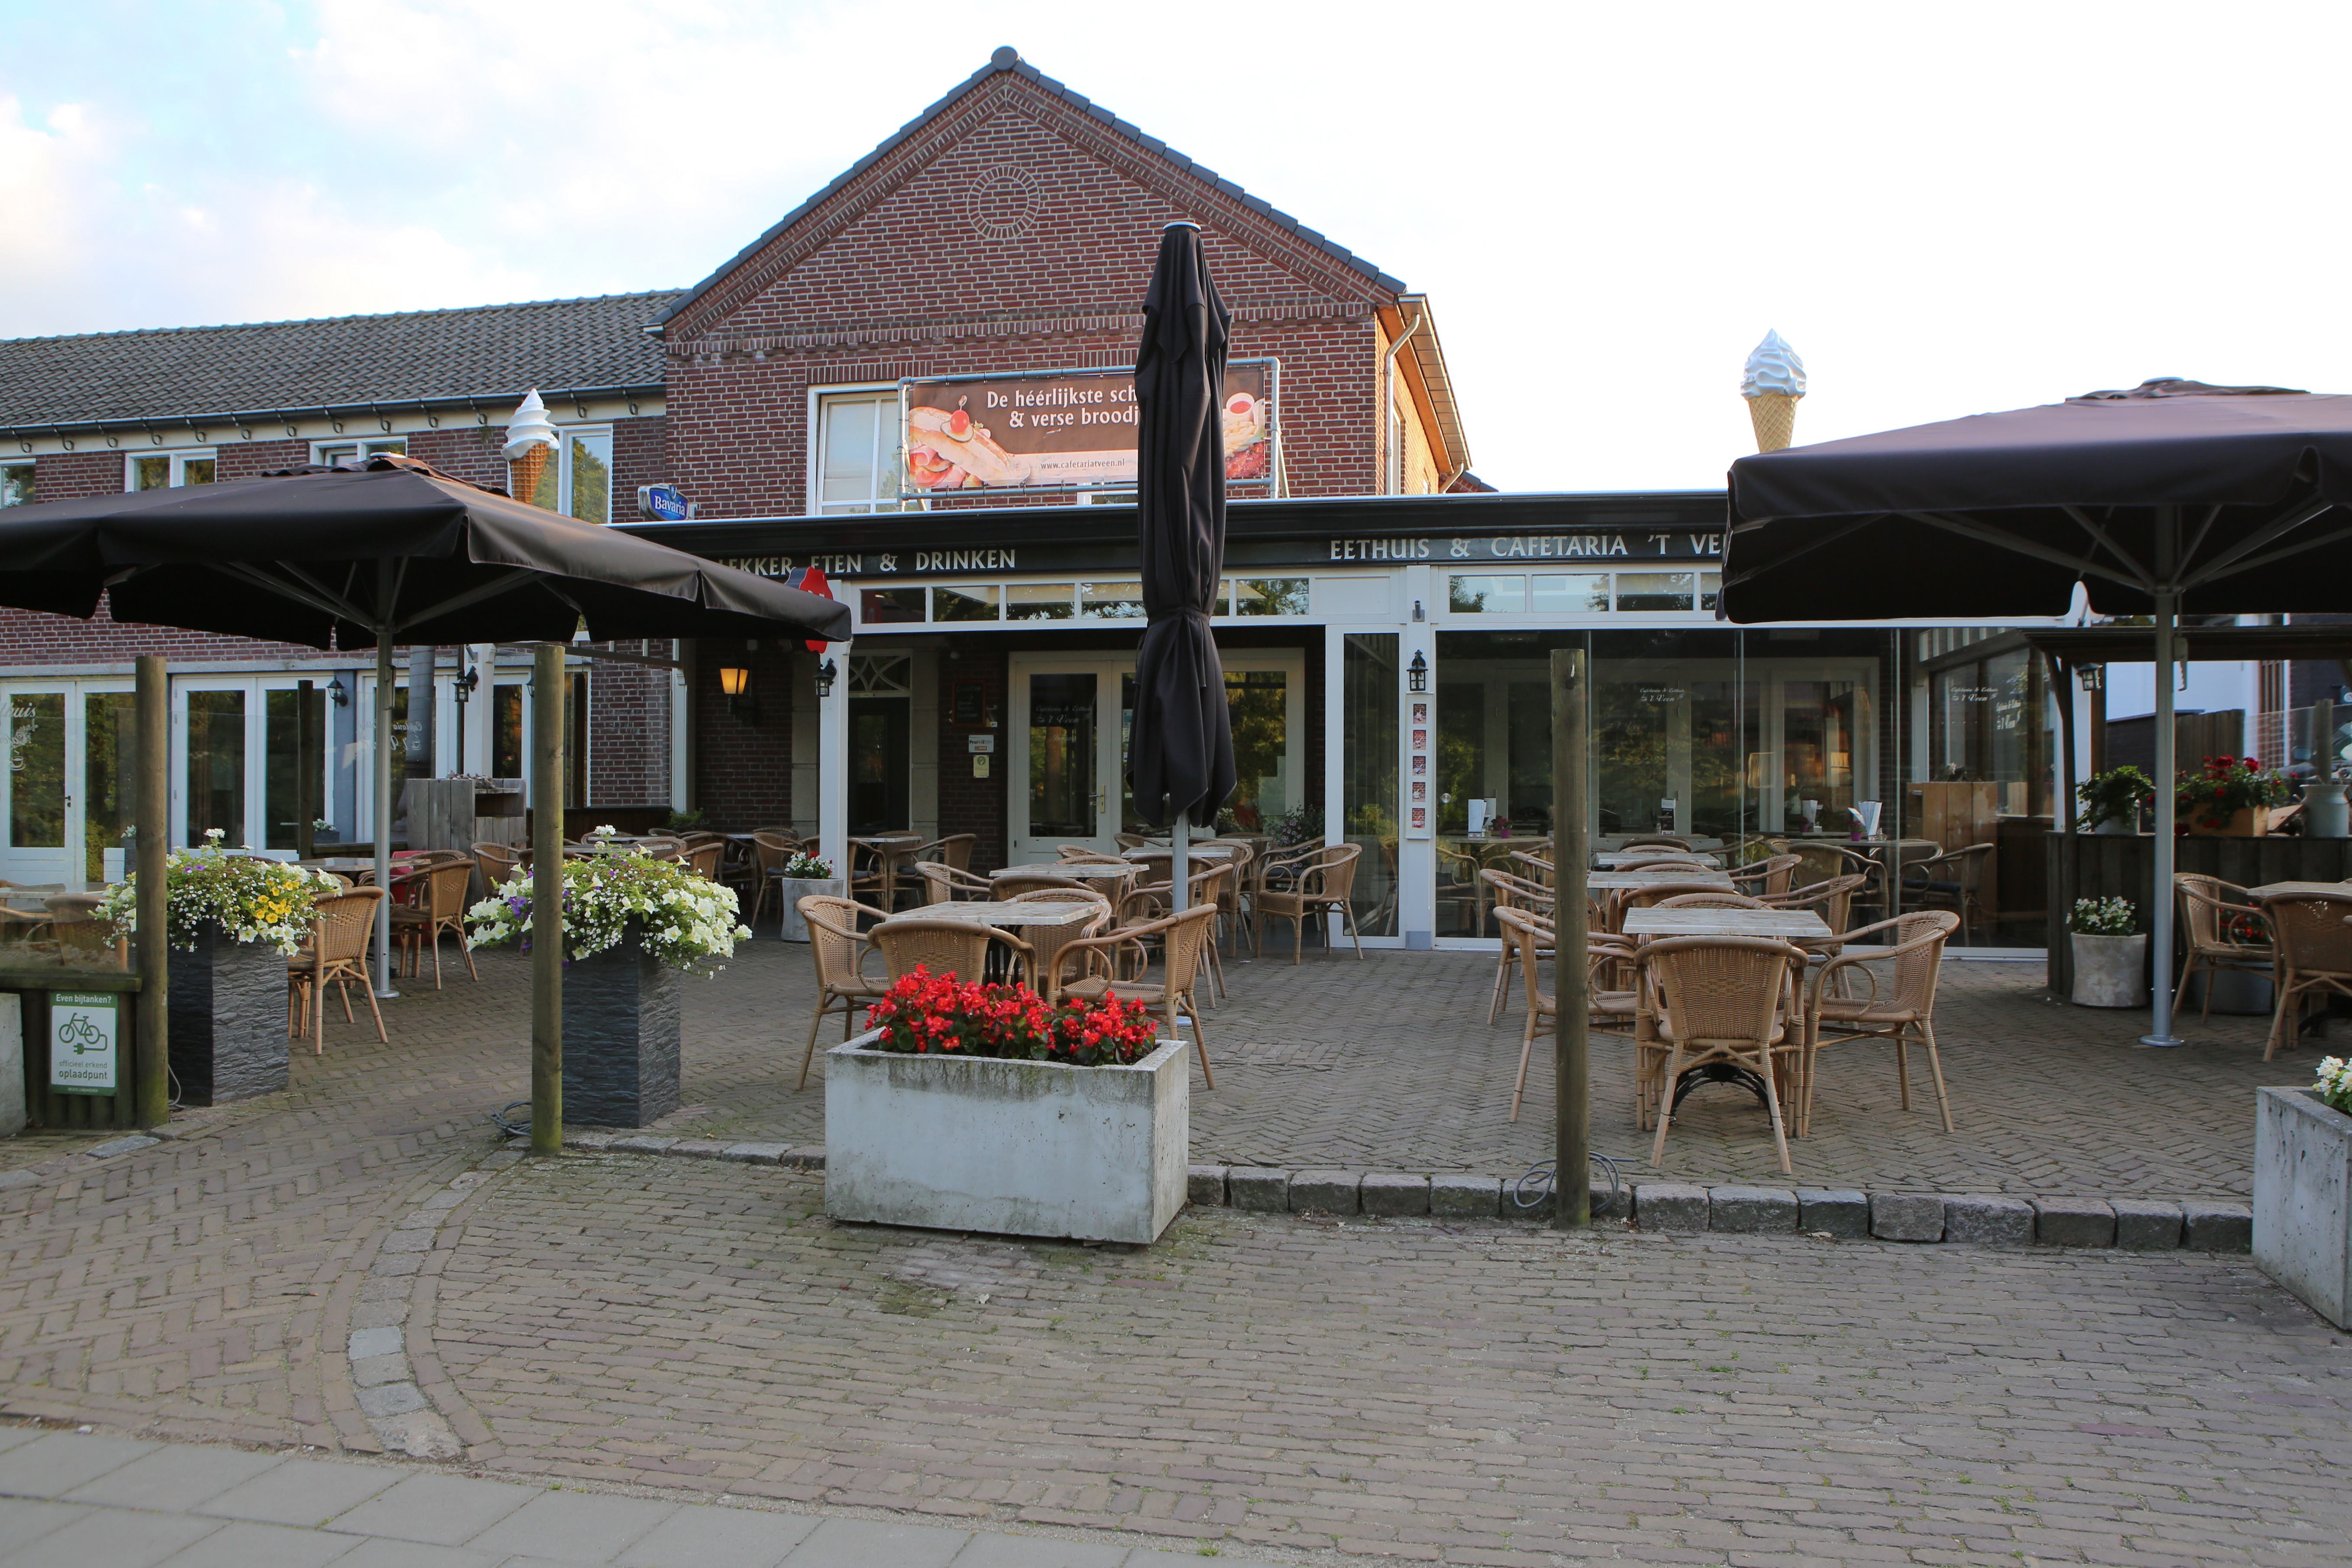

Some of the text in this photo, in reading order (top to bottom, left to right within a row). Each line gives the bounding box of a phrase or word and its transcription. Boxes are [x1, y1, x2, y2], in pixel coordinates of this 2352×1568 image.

[987, 385, 1137, 408] De héérlijkste sch
[1009, 405, 1139, 428] & verse broodj
[1040, 458, 1125, 469] www.cafetariatveen.nl
[655, 495, 685, 516] Bavaria
[1330, 538, 1429, 559] EETHUIS
[1450, 538, 1471, 557] &
[1491, 535, 1628, 556] CAFETARIA
[1690, 534, 1726, 554] VE
[880, 553, 898, 572] &
[916, 549, 1016, 571] DRINKEN
[56, 994, 111, 1004] Even bijtanken?
[59, 1069, 107, 1080] oplaadpunt
[85, 1061, 107, 1069] erkend
